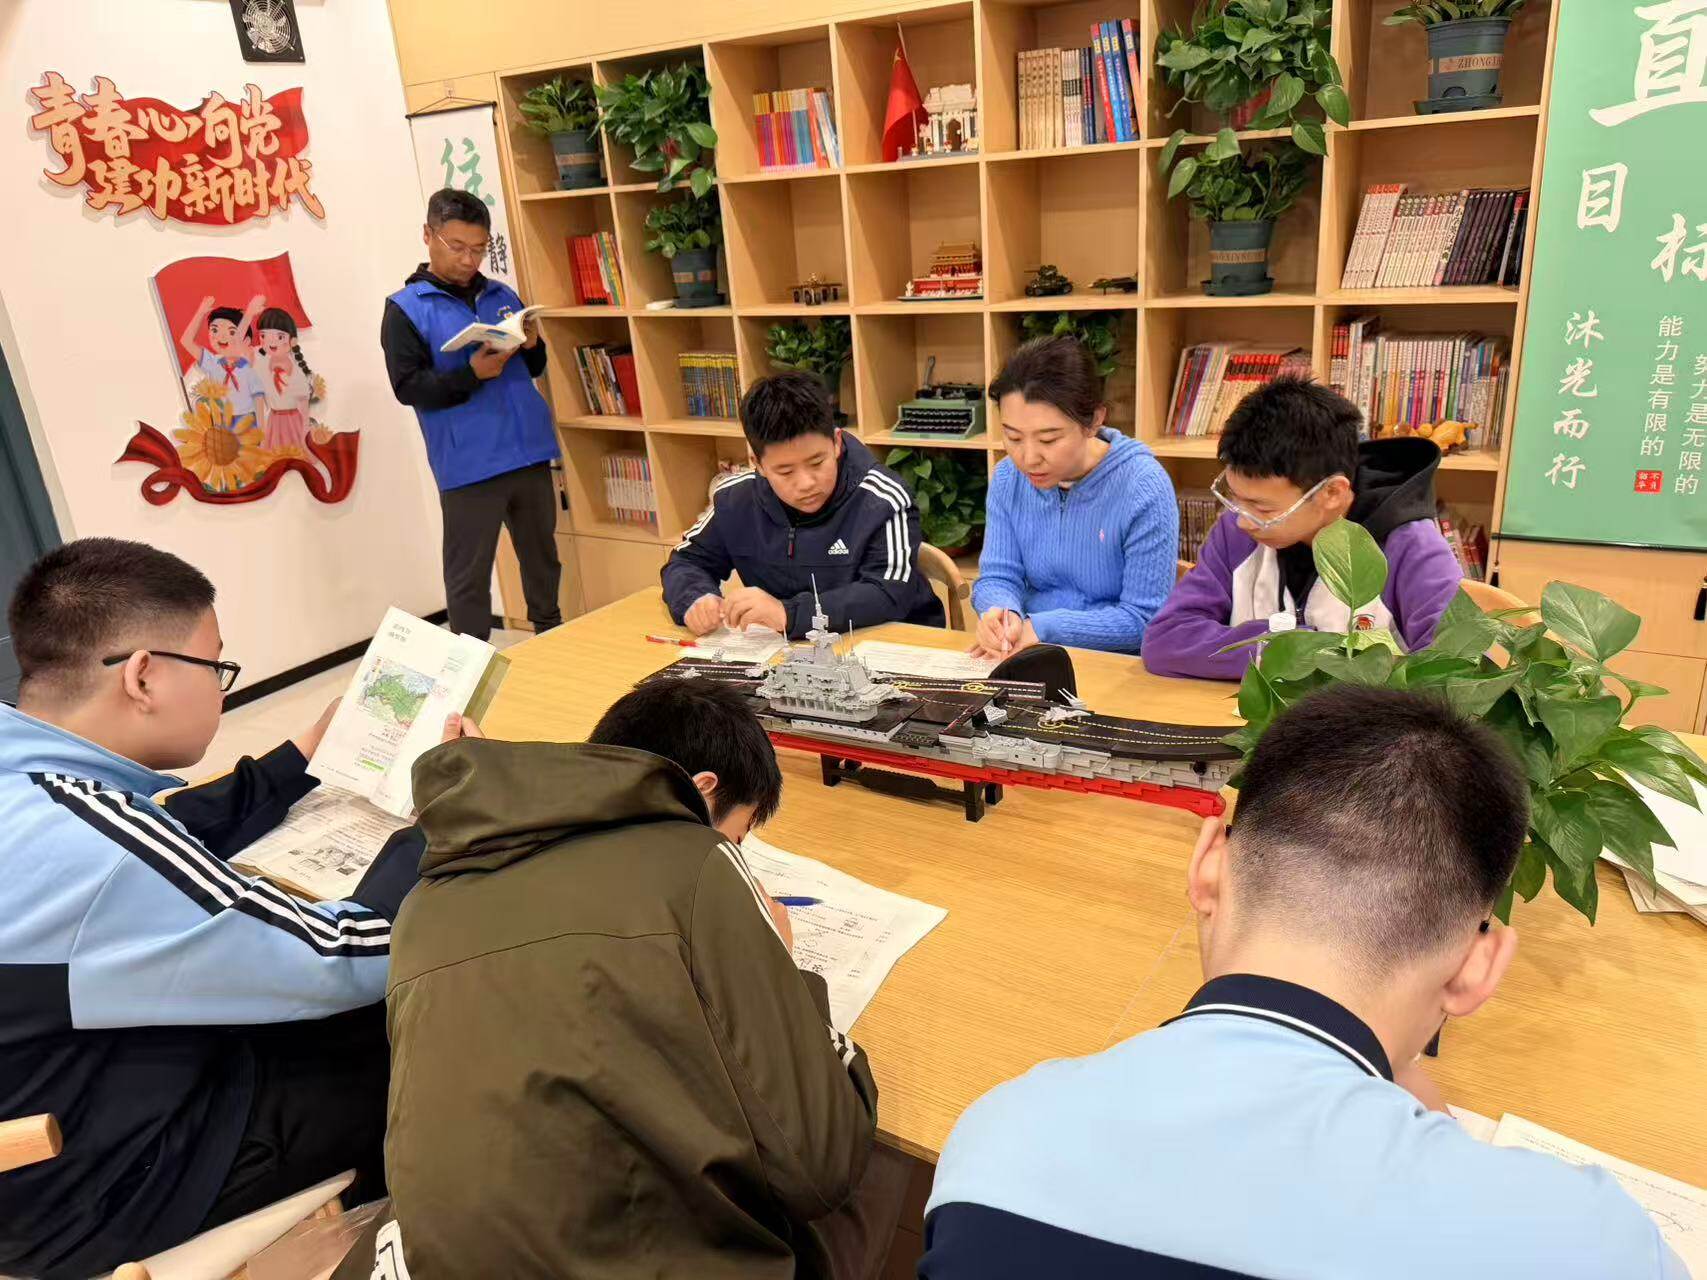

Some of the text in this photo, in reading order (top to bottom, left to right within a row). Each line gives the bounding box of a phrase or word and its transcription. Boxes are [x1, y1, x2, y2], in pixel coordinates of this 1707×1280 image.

[31, 71, 282, 186] 青春心向党
[86, 153, 325, 224] 建功新时代
[1577, 162, 1628, 232] 目
[1544, 310, 1604, 489] 沐光而行
[1640, 315, 1683, 457] 能力是有限的
